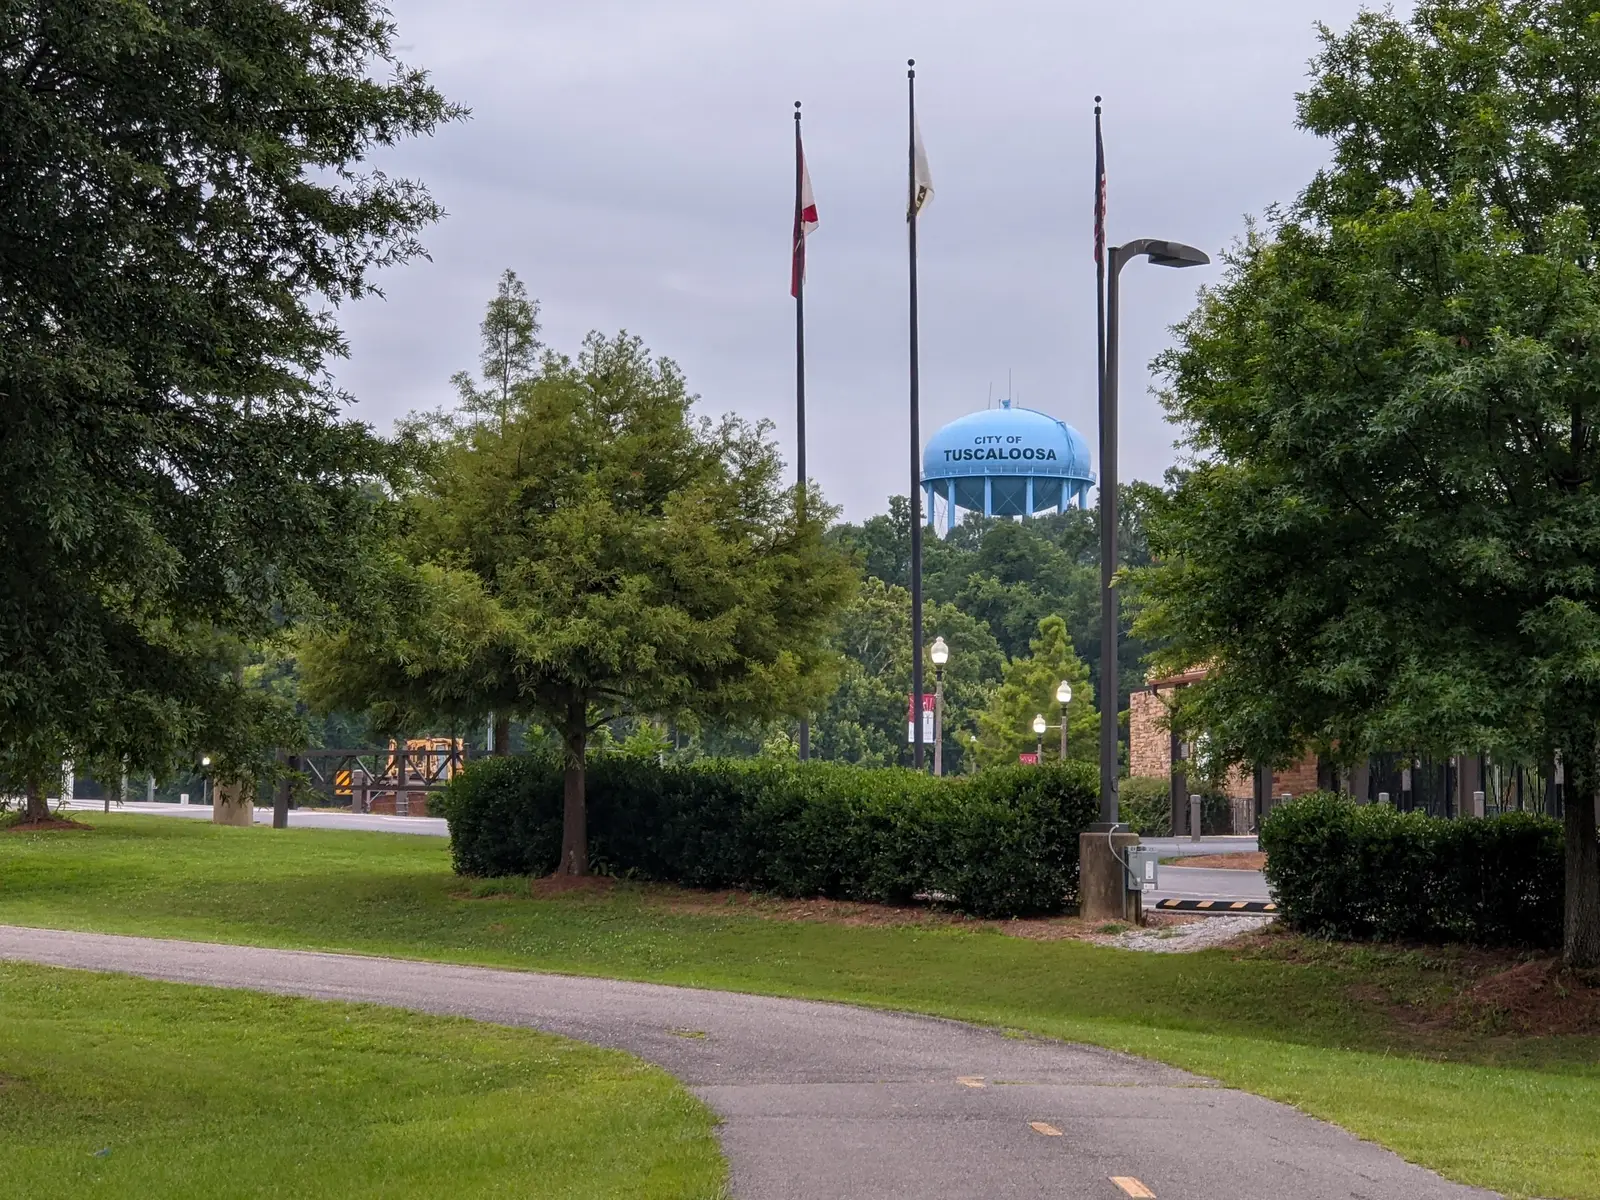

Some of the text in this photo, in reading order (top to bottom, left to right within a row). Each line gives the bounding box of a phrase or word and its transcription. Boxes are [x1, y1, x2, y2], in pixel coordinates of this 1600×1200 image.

[974, 435, 1022, 445] CITY OF
[943, 448, 1057, 461] TUSCALOOSA
